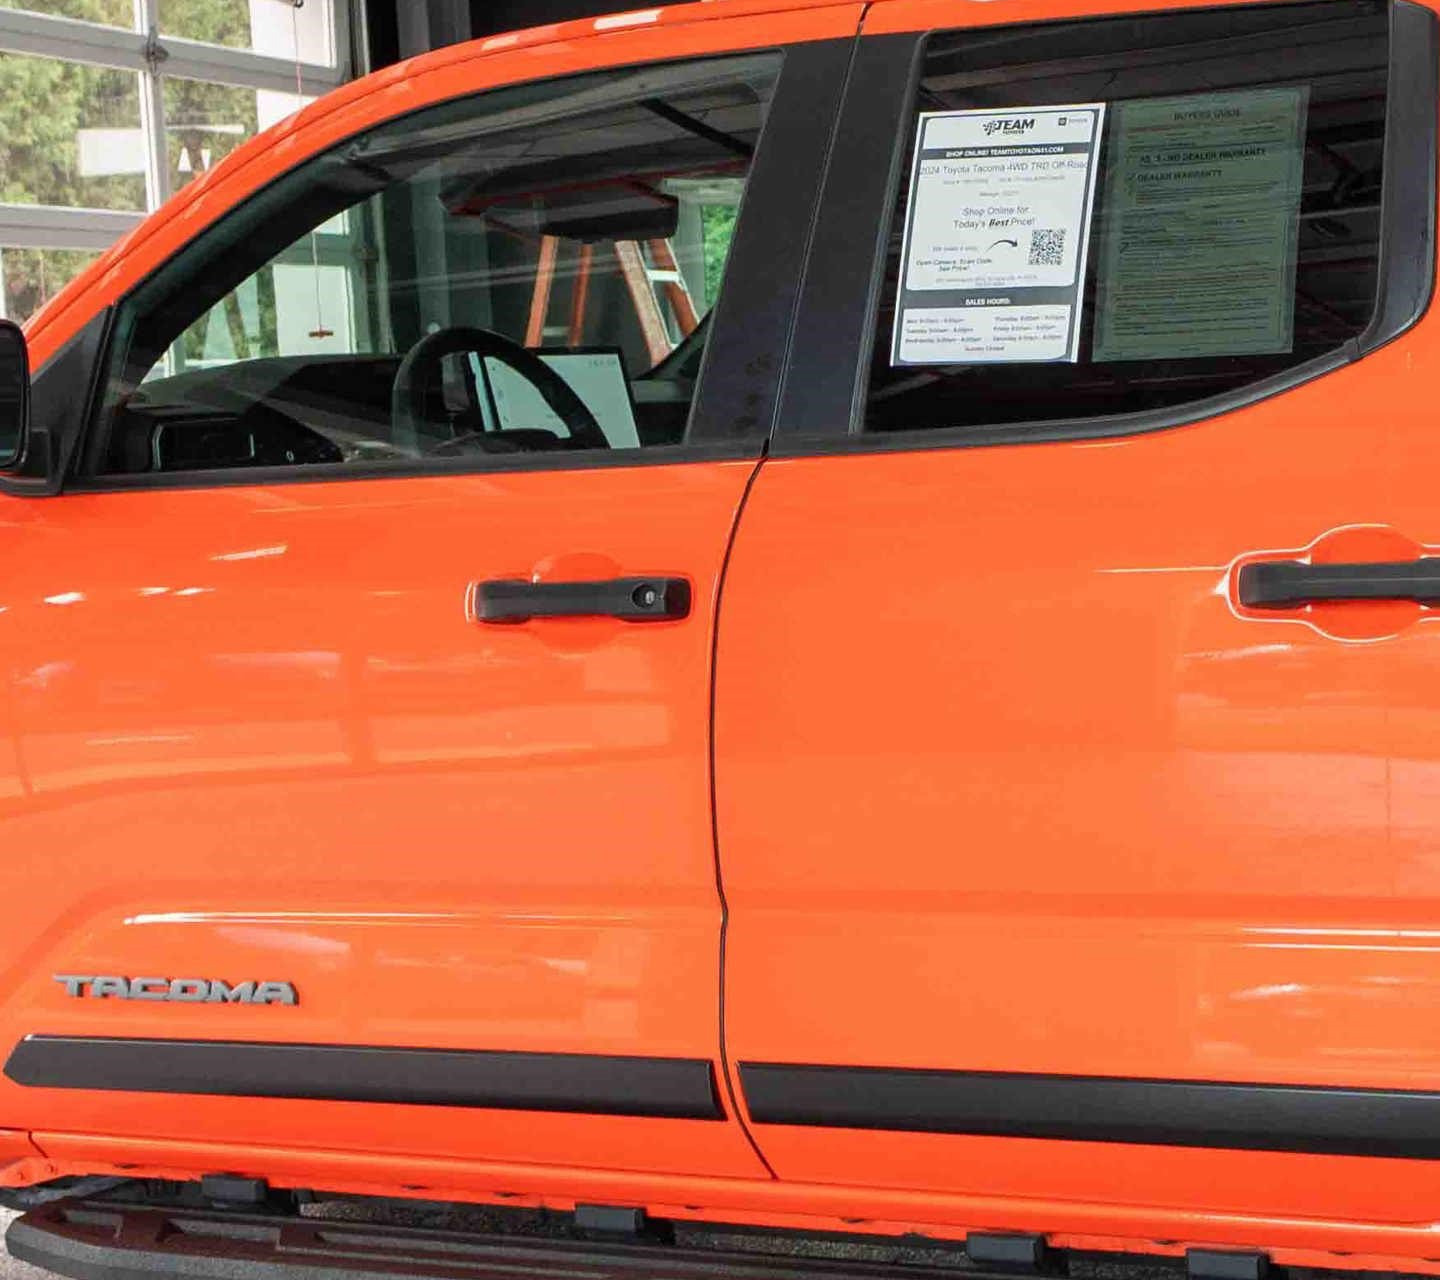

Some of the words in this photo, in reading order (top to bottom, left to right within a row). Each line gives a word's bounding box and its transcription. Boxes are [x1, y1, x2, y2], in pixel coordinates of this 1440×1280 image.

[996, 118, 1036, 131] TEAM
[943, 166, 970, 177] Toyota
[973, 163, 1005, 173] Tacoma
[961, 207, 985, 217] Shop
[987, 206, 1014, 216] Online
[1017, 206, 1029, 214] for
[954, 220, 986, 229] Today's
[988, 219, 1009, 227] Best
[52, 973, 300, 1006] TACOMA
